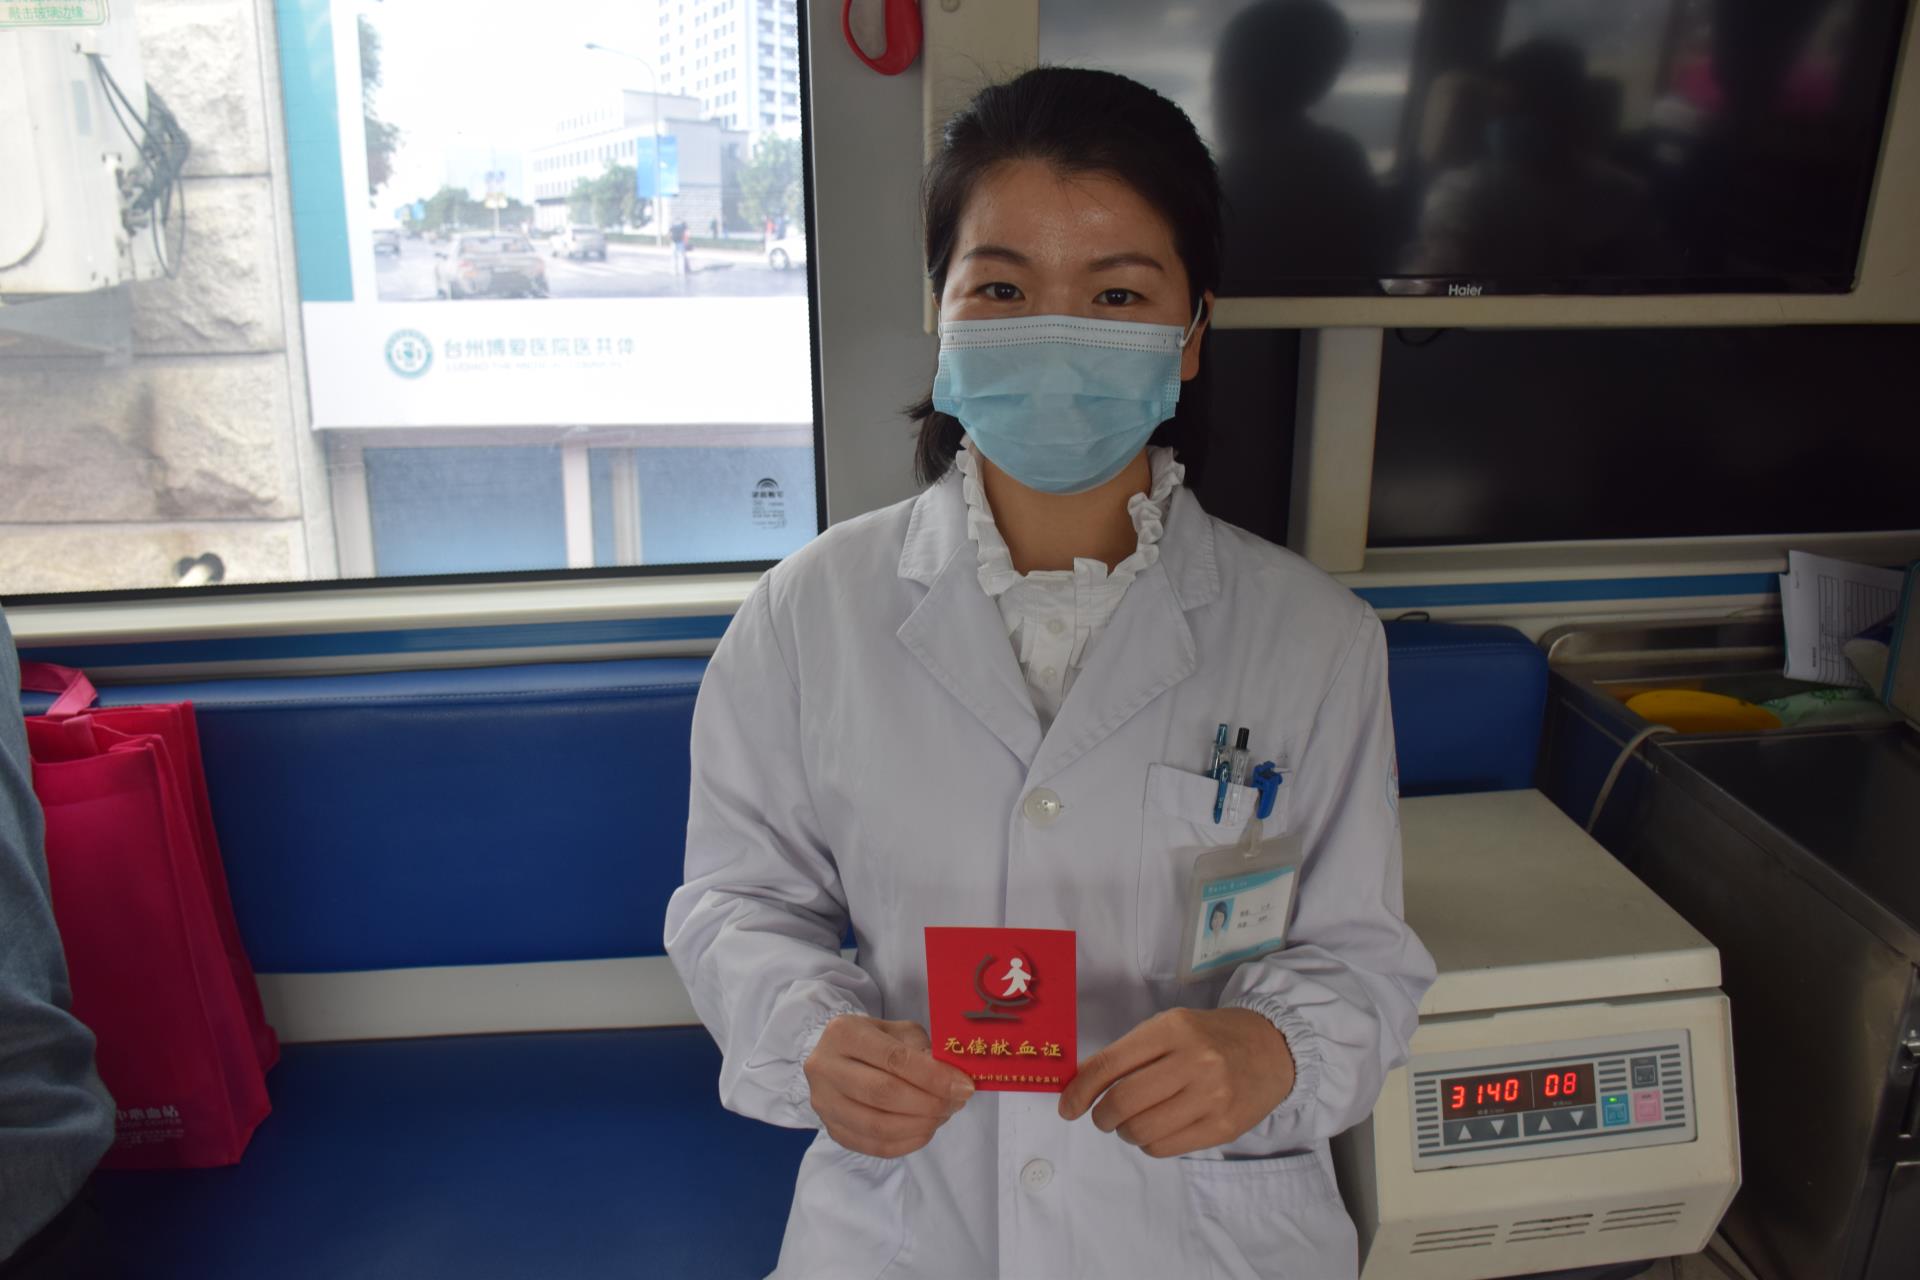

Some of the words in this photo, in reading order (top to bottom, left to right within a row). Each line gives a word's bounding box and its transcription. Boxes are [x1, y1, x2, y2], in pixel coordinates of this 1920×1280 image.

[1448, 284, 1482, 296] Haier
[444, 336, 636, 359] 台州博爱医院医共体
[944, 1037, 1062, 1057] 无偿献血证
[1451, 1078, 1519, 1110] 3140
[1544, 1072, 1577, 1097] 08
